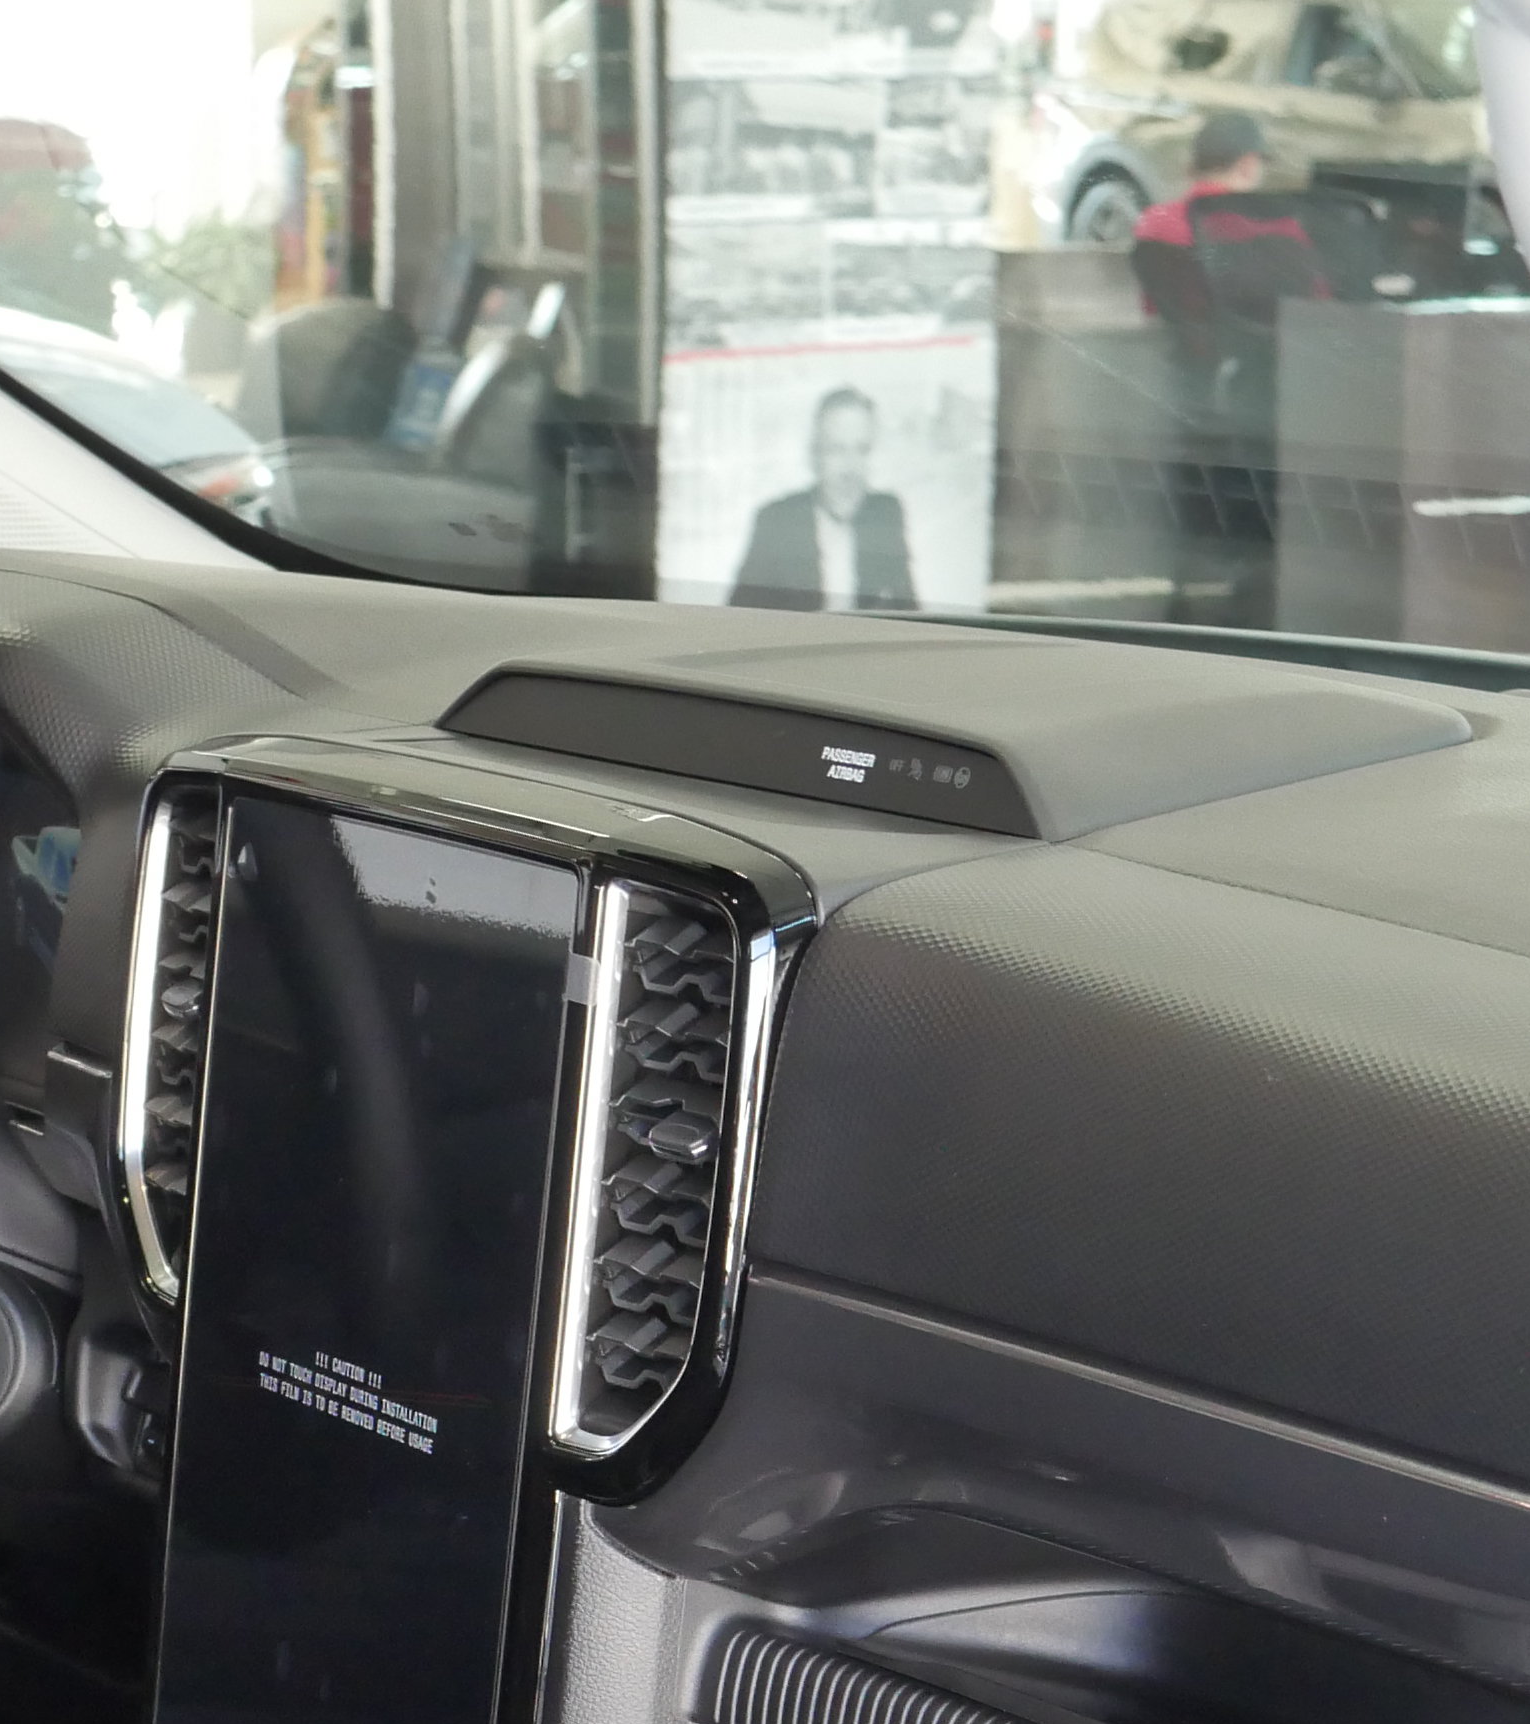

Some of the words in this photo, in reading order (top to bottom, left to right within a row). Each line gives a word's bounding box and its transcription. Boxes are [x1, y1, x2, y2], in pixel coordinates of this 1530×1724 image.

[821, 746, 876, 768] PASSENGER
[826, 764, 865, 783] AIRBAG
[315, 1351, 329, 1369] !!!
[332, 1357, 365, 1383] CAUTION
[368, 1371, 382, 1390] !!!
[258, 1351, 270, 1368] DO
[272, 1356, 287, 1373] NOT
[289, 1361, 312, 1385] TOUCH
[314, 1372, 347, 1398] DISPLAY
[349, 1386, 378, 1412] DURING
[381, 1398, 438, 1434] INSTALLATION
[259, 1372, 278, 1393] THIS
[280, 1380, 299, 1401] FILM
[302, 1389, 312, 1406] IS
[315, 1394, 325, 1412] TO
[327, 1399, 339, 1417] BE
[341, 1405, 374, 1431] REMOVED
[376, 1419, 406, 1444] BEFORE
[408, 1431, 434, 1455] USAGE
